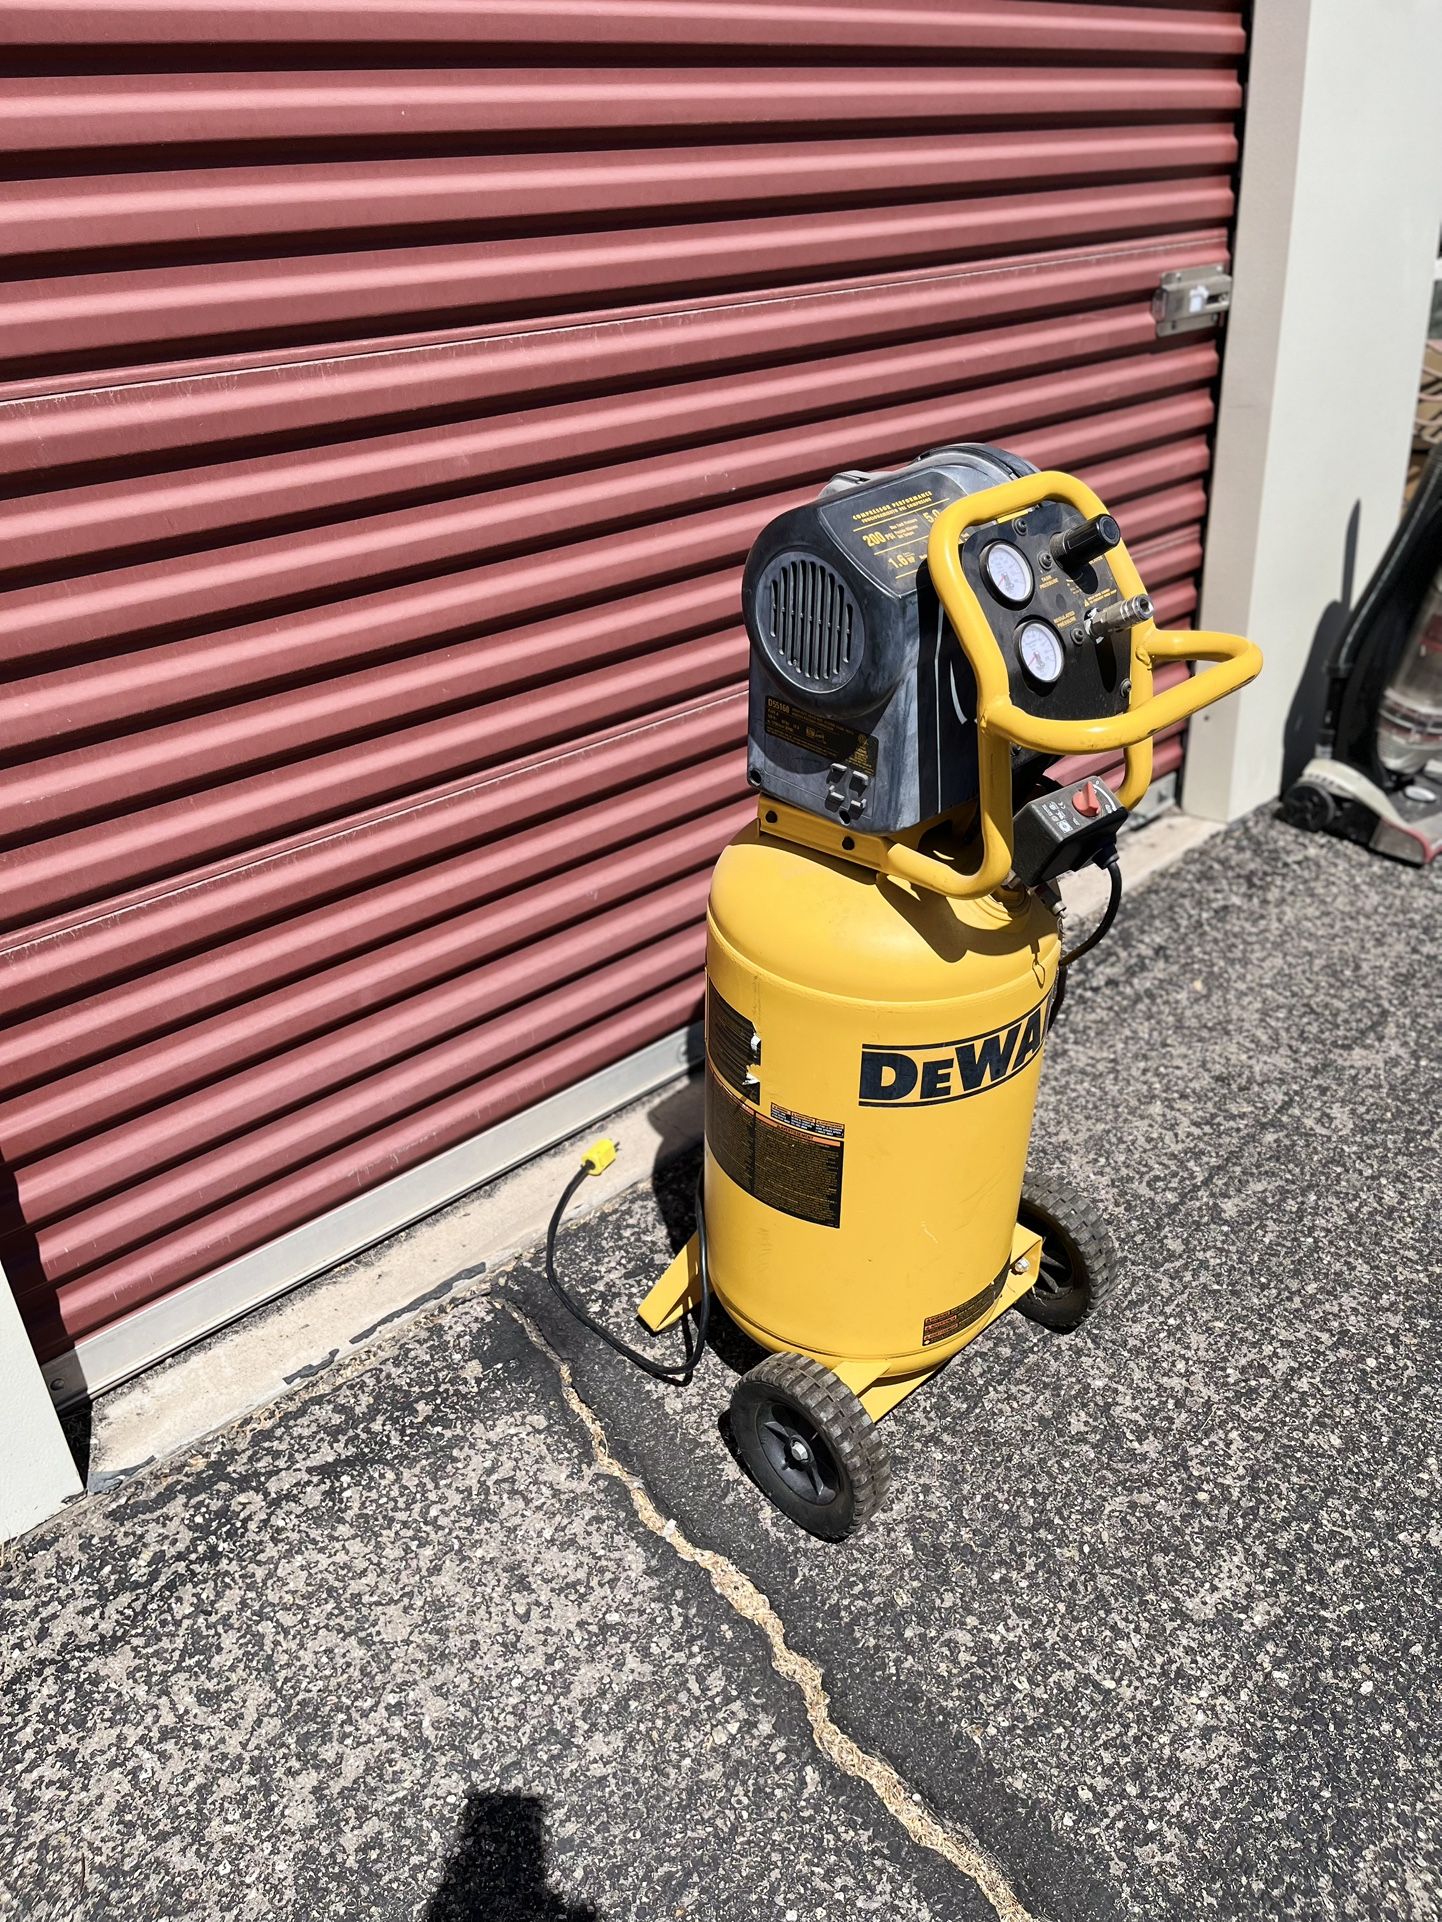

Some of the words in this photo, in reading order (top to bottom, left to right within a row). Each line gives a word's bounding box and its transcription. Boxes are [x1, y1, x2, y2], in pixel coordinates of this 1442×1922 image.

[853, 504, 891, 520] COMPRESSOR
[892, 490, 933, 508] PERFORMANCE
[863, 531, 887, 548] 200
[888, 554, 909, 569] 1.6
